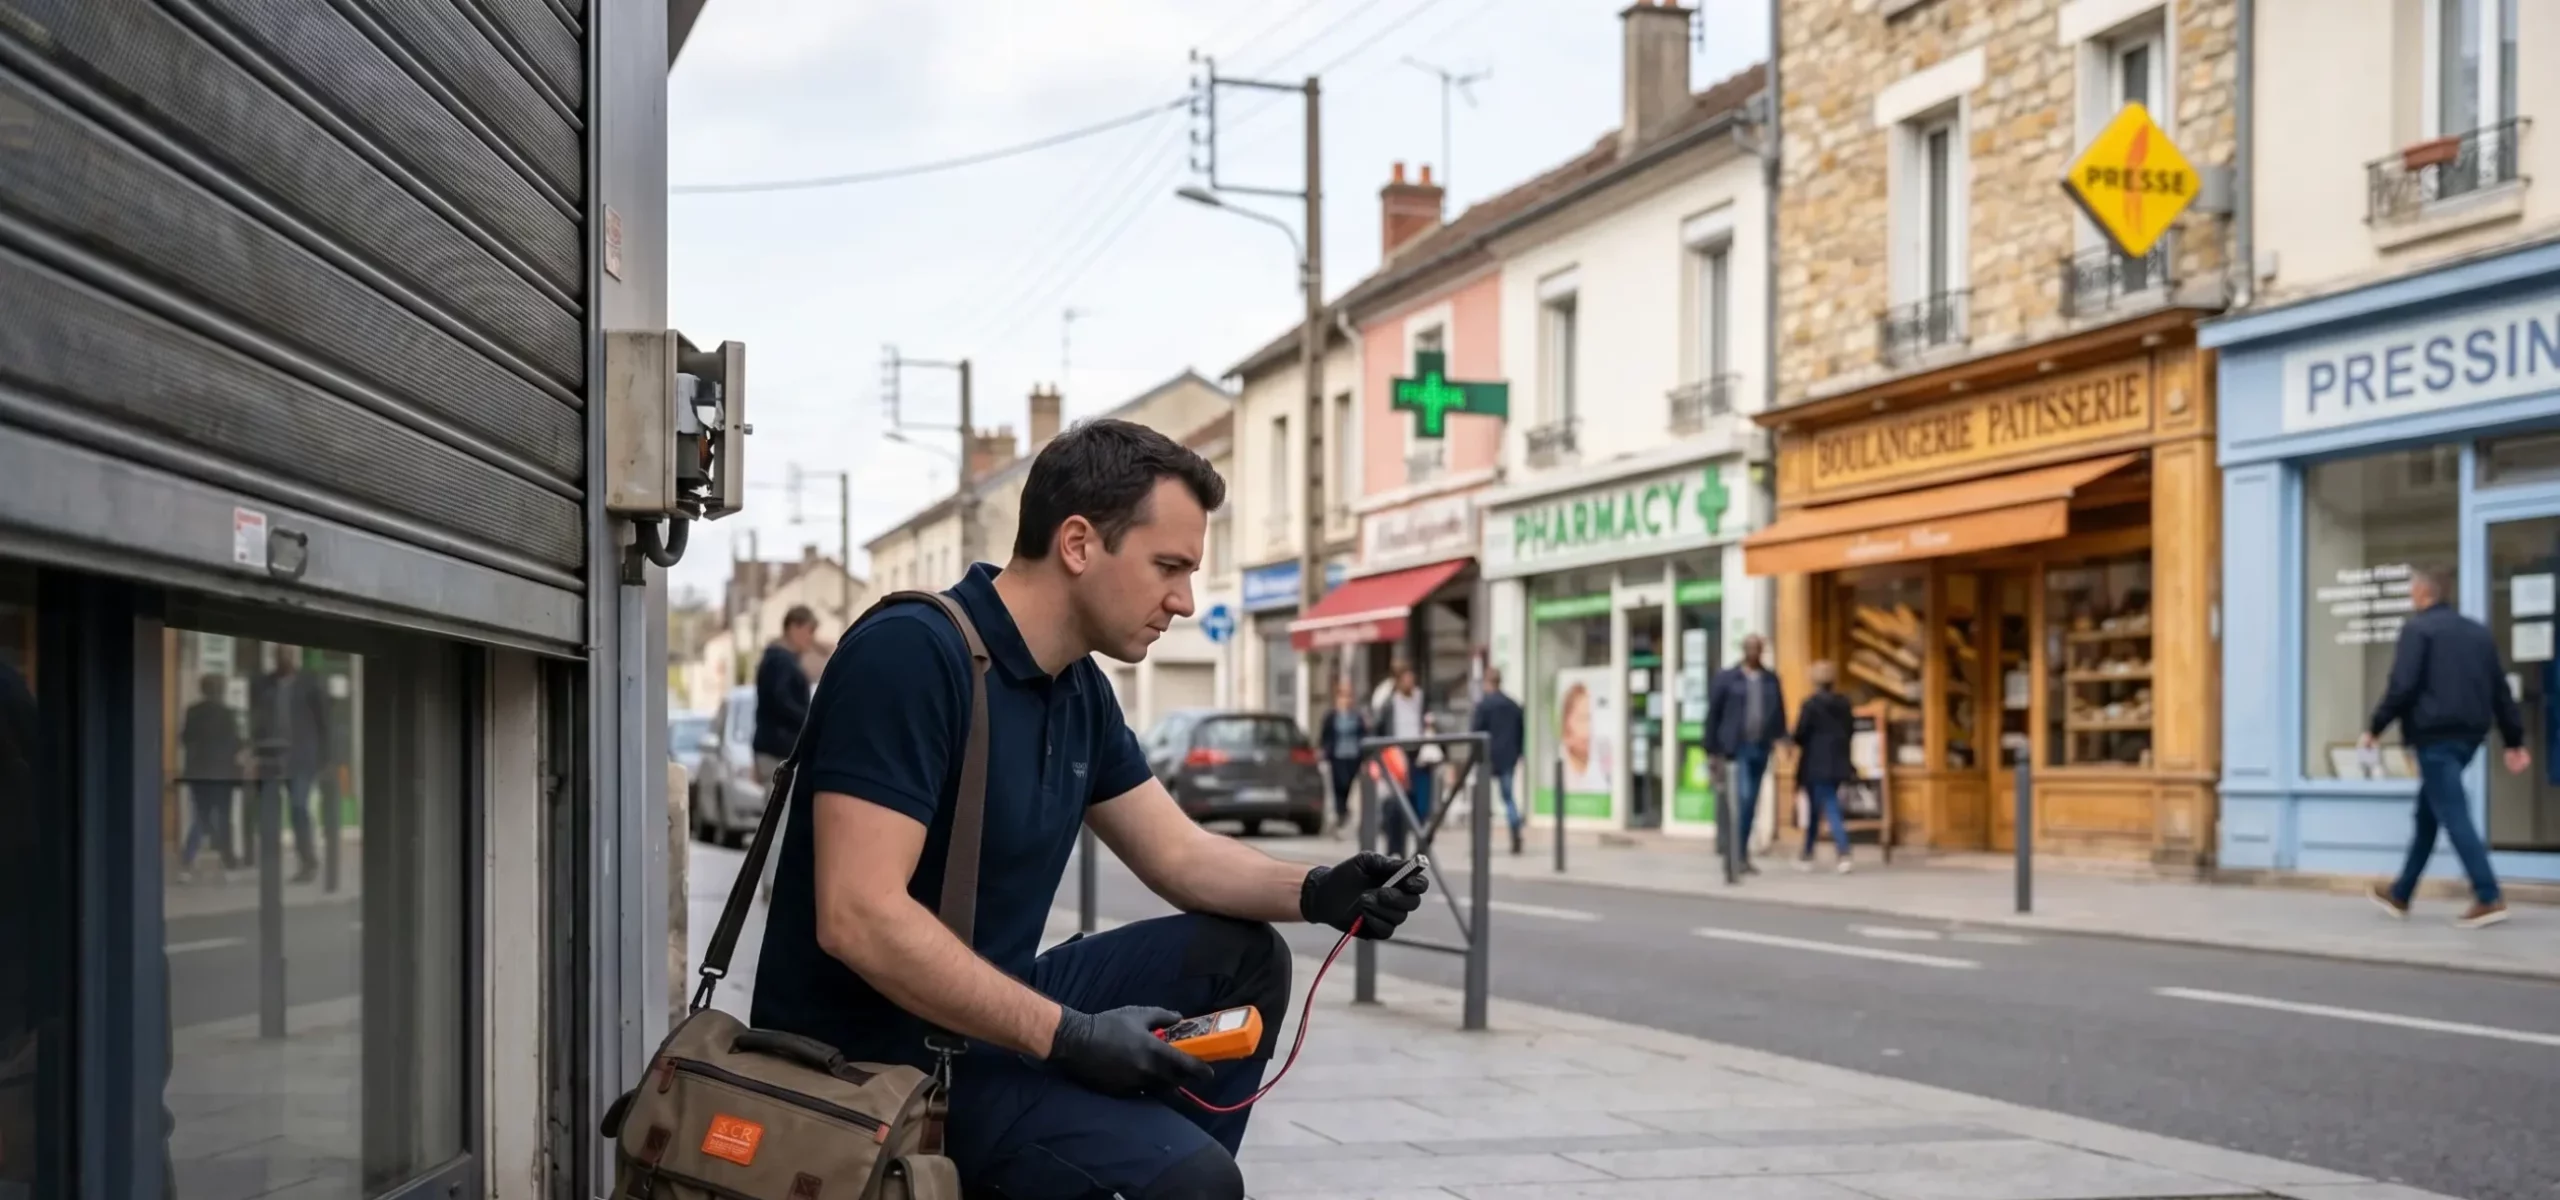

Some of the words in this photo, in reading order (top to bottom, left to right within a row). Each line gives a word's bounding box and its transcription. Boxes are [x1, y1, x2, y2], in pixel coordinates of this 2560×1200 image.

[2086, 166, 2187, 196] PRESSE
[1818, 411, 1974, 477] BOULANGERIE
[1987, 373, 2141, 446] PATISSERIE
[1514, 482, 1683, 556] PHARMACY
